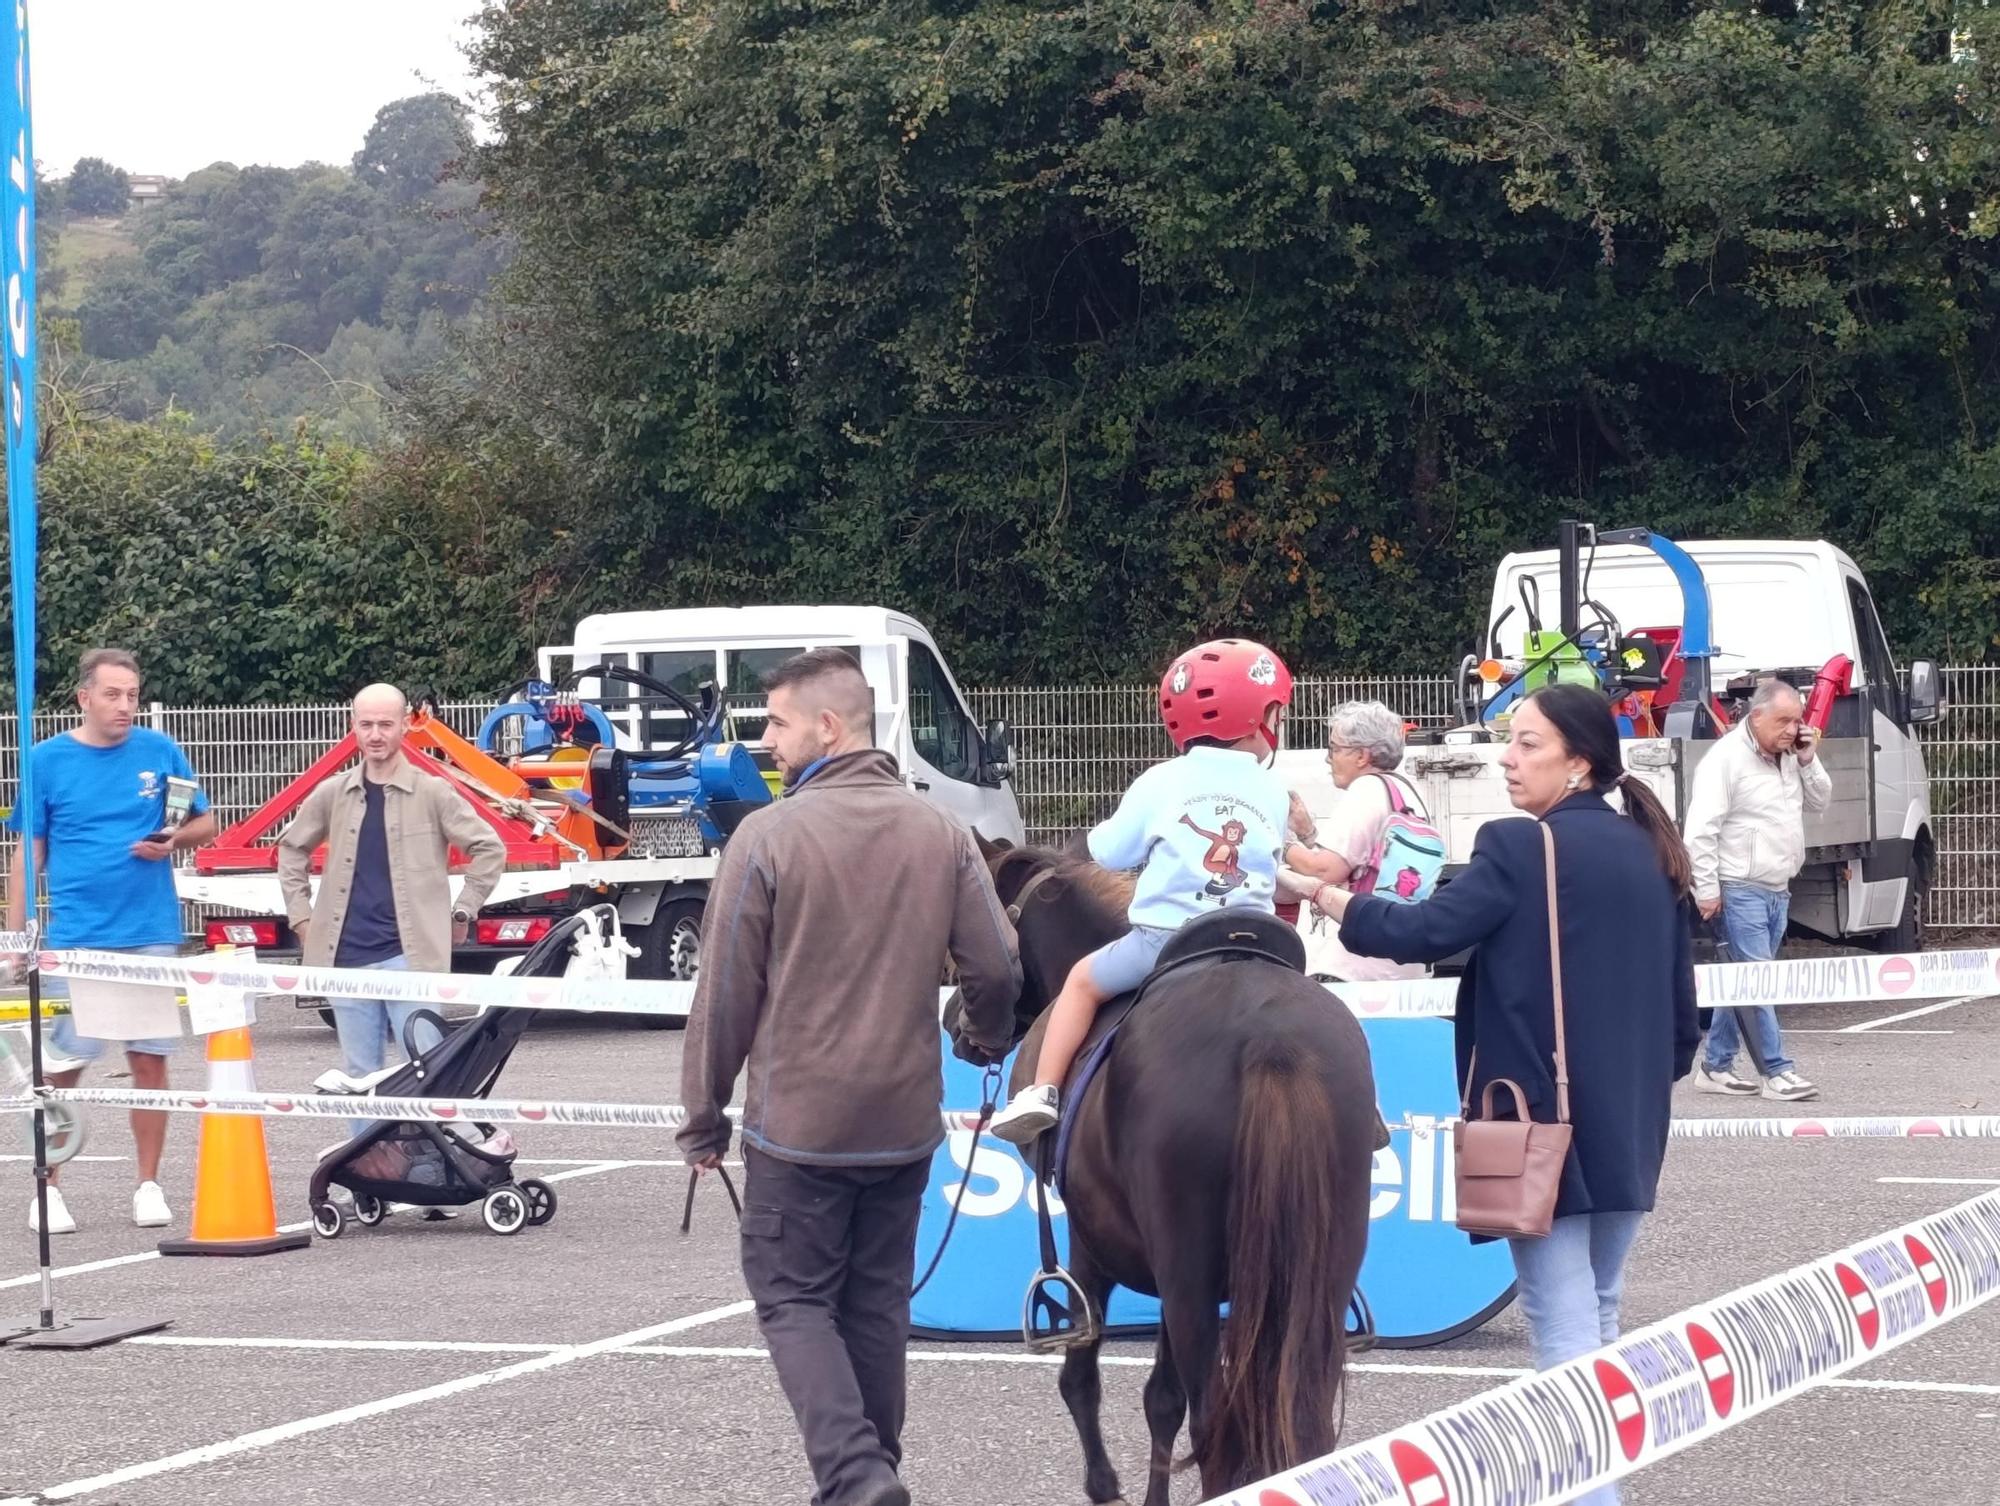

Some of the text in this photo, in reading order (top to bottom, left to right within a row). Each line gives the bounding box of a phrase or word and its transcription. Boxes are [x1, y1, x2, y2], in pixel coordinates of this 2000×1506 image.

[1215, 805, 1236, 816] EAT
[1726, 1276, 1841, 1400] POLICIA LOCAL
[1446, 1377, 1592, 1506] POLICIA LOCAL
